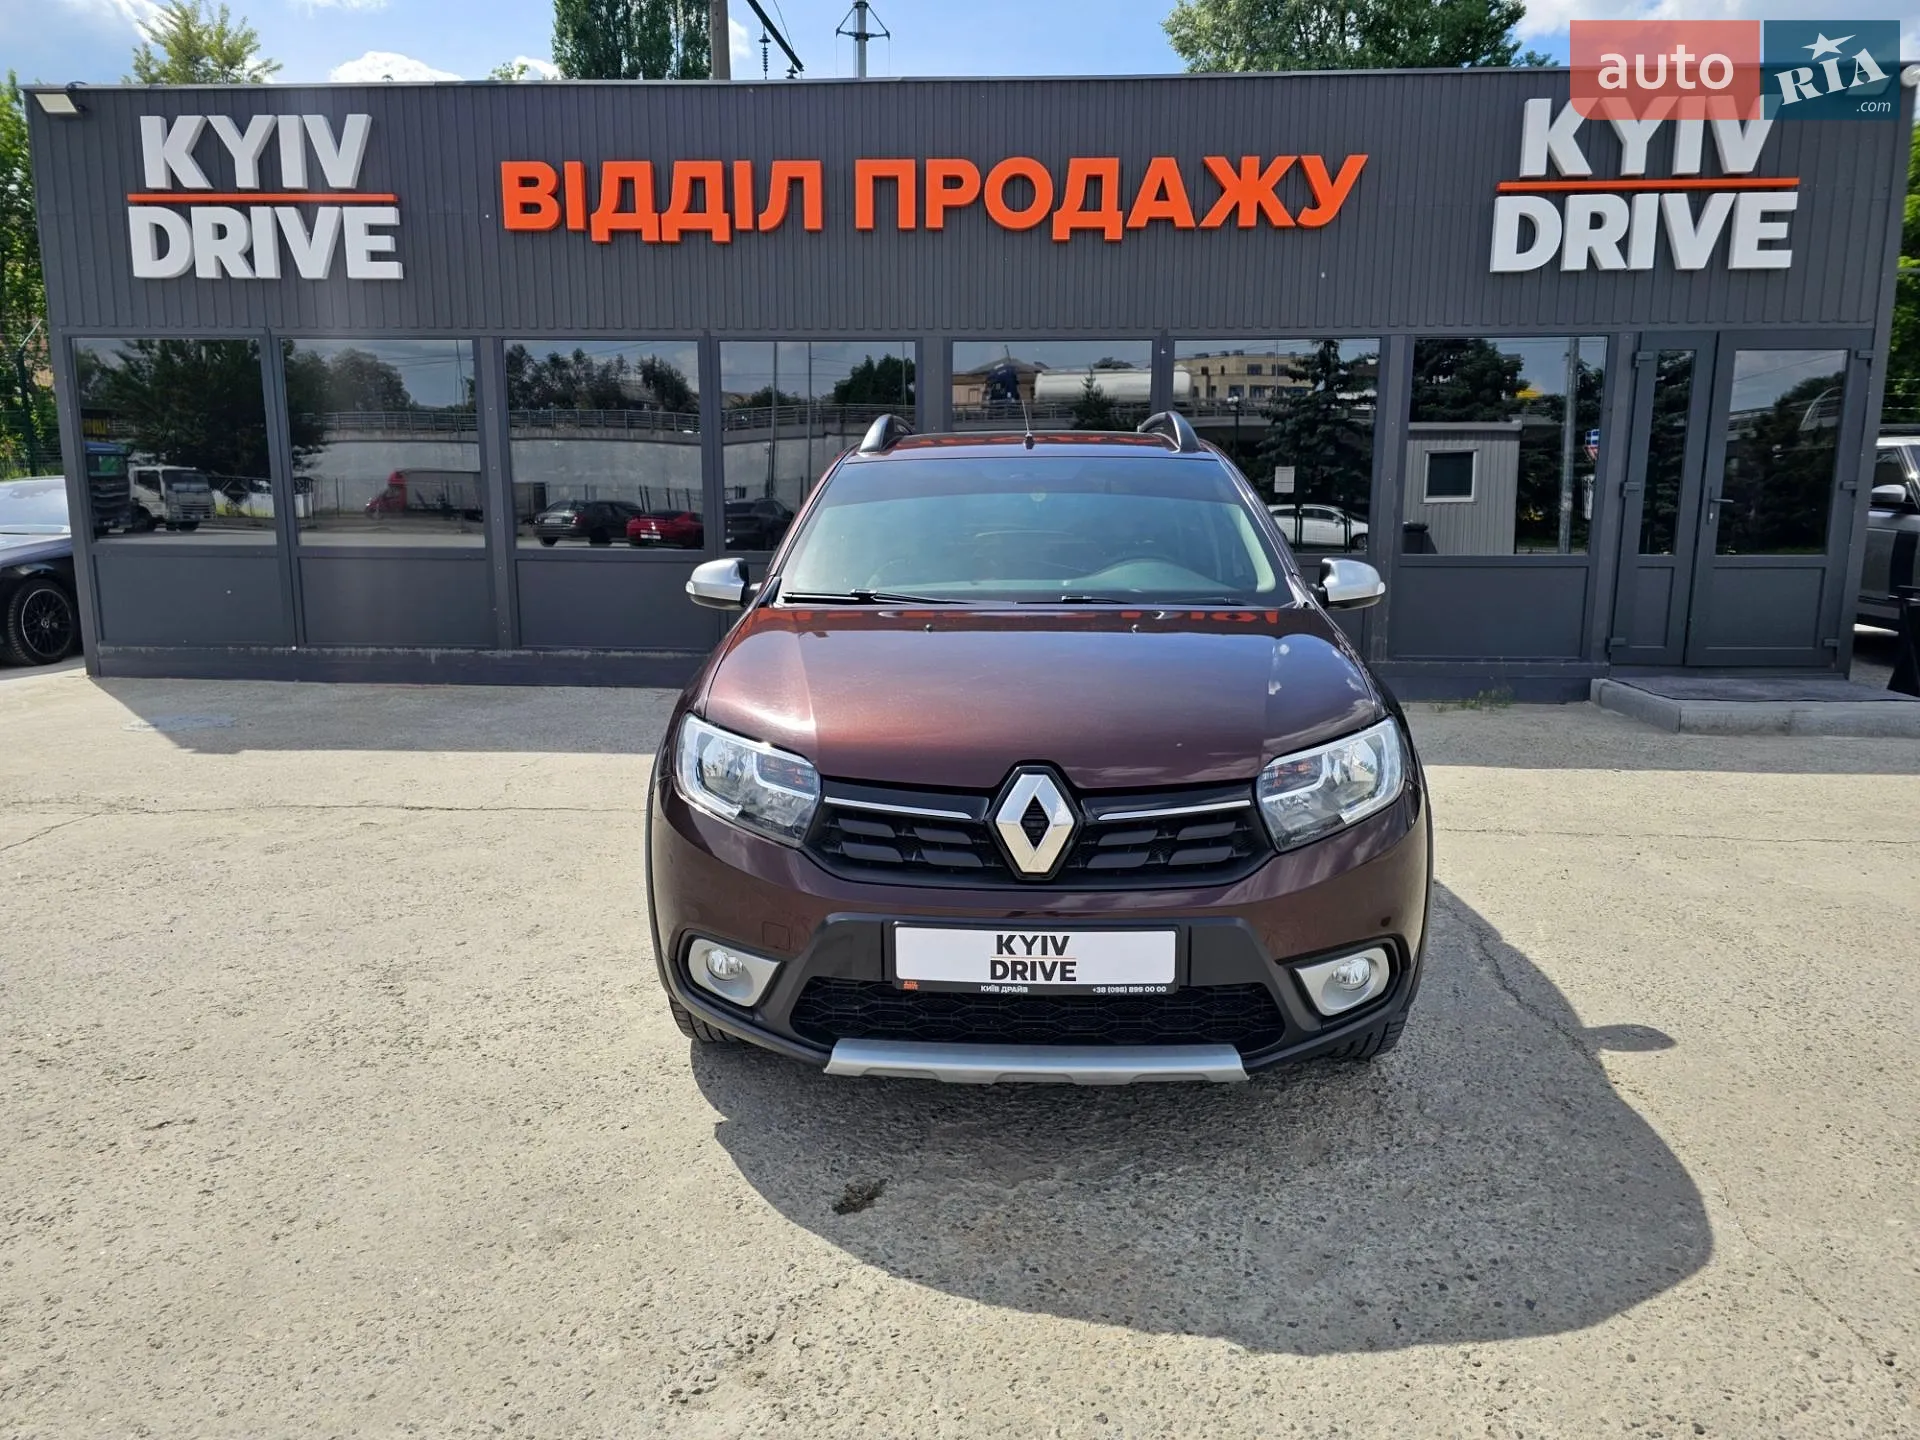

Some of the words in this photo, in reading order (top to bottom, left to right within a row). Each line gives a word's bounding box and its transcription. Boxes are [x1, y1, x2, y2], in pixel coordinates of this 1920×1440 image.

[139, 114, 372, 189] KYIV
[1519, 96, 1778, 177] KYIV
[501, 160, 823, 242] ВІДДІЛ
[854, 154, 1367, 241] ПРОДАЖУ
[1490, 192, 1798, 273] DRIVE
[127, 206, 404, 280] DRIVE
[990, 960, 1077, 982] DRIVE
[996, 934, 1070, 956] KYIV
